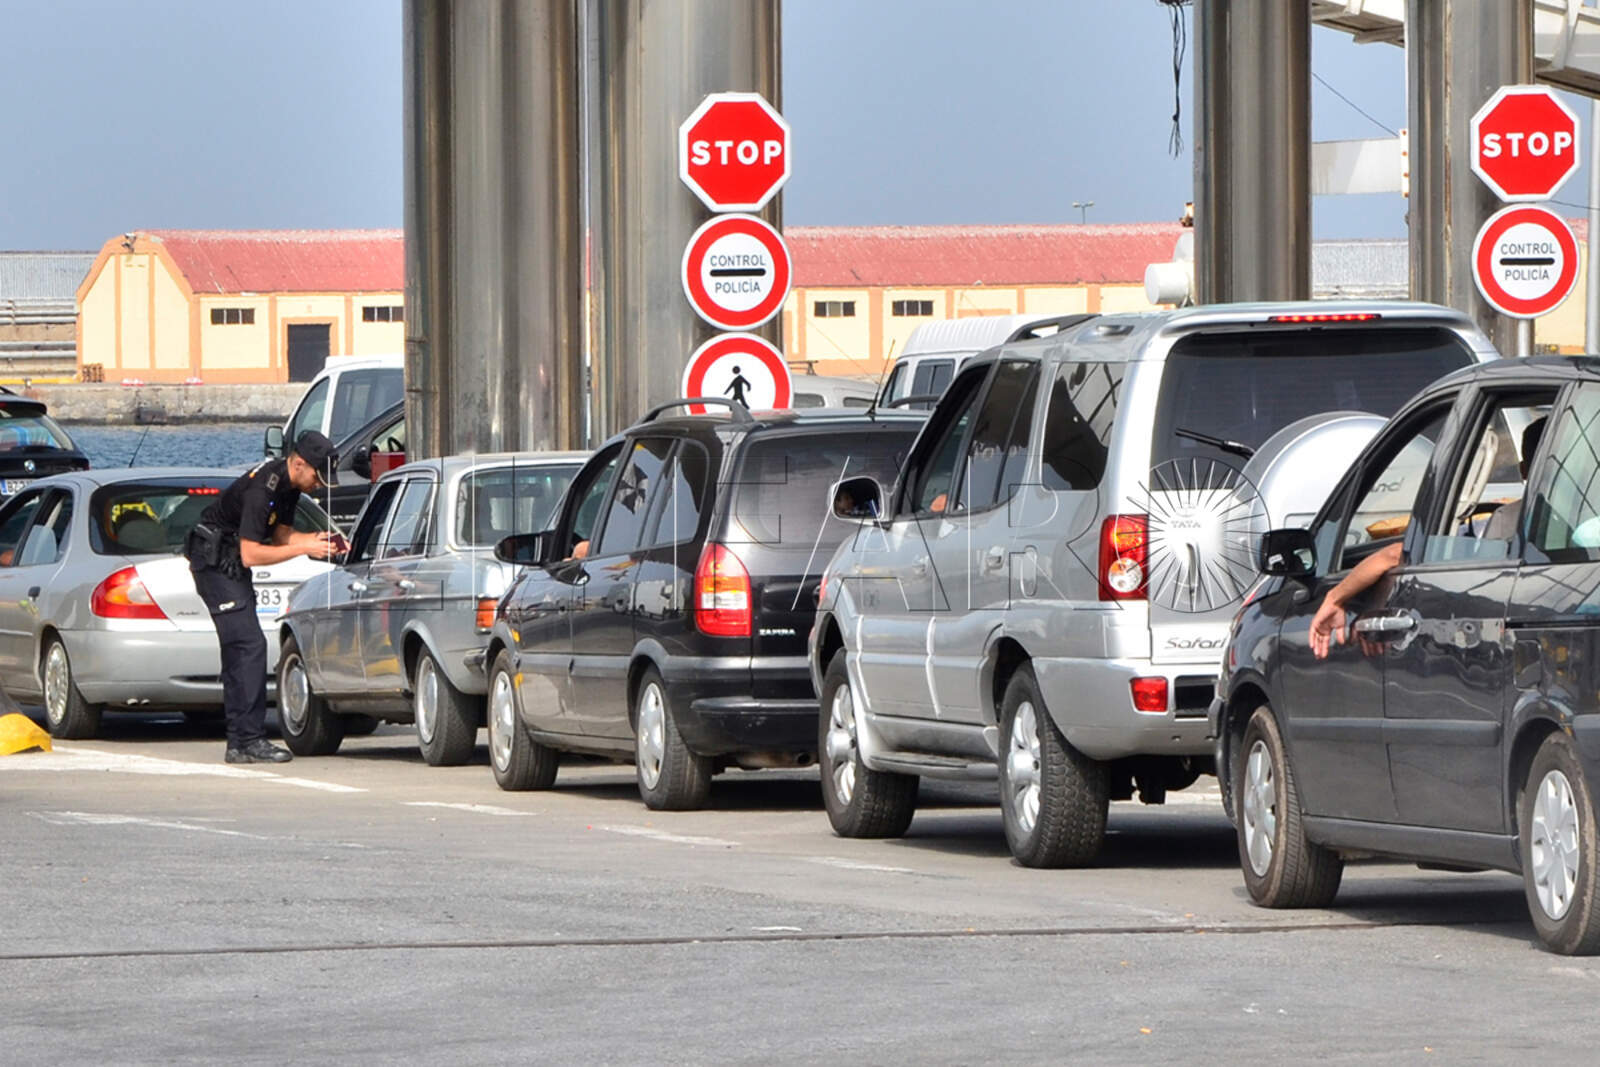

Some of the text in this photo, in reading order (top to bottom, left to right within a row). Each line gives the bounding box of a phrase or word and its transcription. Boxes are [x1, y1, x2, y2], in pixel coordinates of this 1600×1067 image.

[1482, 131, 1572, 158] STOP
[690, 140, 782, 166] STOP
[1500, 242, 1556, 255] CONTROL
[710, 254, 766, 267] CONTROL
[1505, 265, 1550, 281] POLICÍA
[715, 279, 761, 294] POLICÍA
[1170, 520, 1202, 529] TATA
[1164, 635, 1228, 650] Safari
